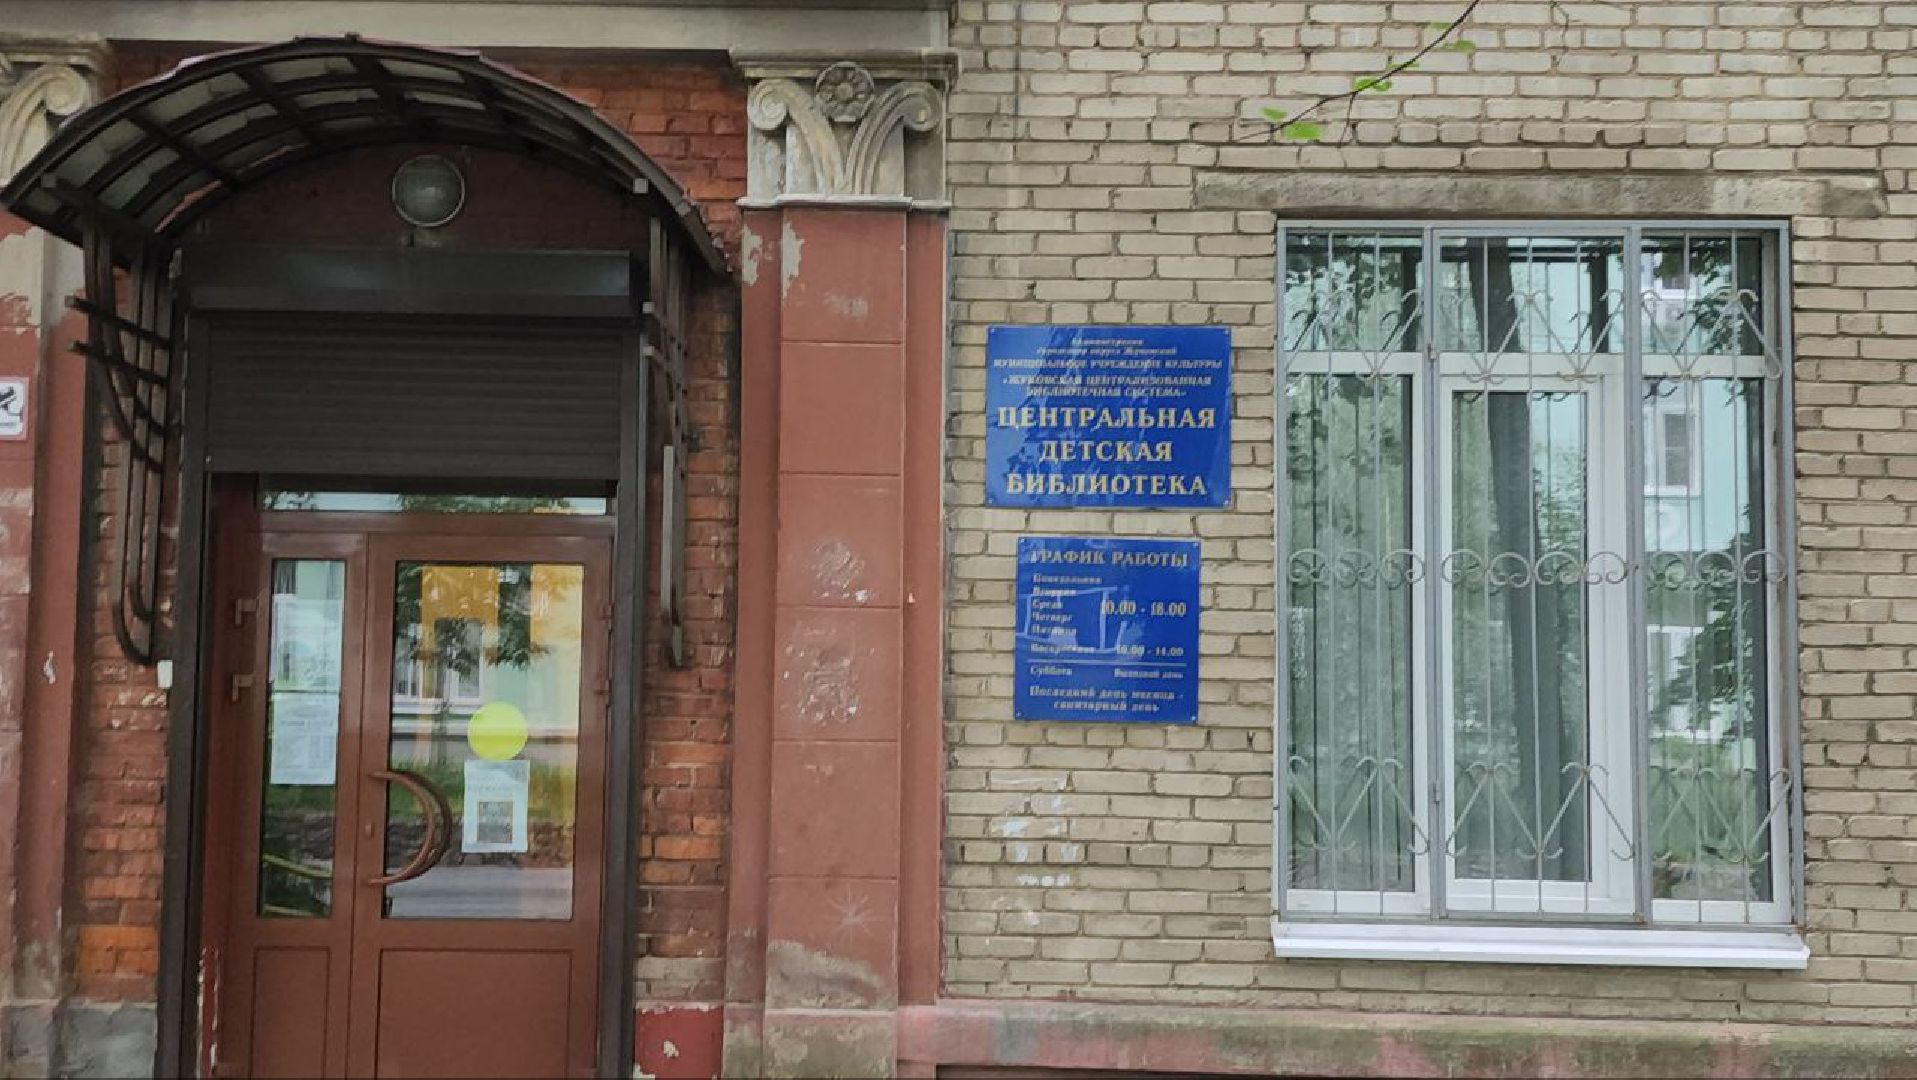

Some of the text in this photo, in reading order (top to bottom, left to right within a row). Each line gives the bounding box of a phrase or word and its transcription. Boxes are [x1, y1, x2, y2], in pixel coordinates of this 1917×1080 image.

[1091, 360, 1161, 369] УЧРЕЖДЕНИЕ
[1165, 360, 1222, 369] КУЛЬТУРЫ
[1087, 376, 1211, 386] ЦЕНТРАЛИЗОВАННАЯ
[997, 407, 1215, 430] ЦЕНТРАЛЬНАЯ
[1039, 440, 1172, 464] ДЕТСКАЯ
[1007, 473, 1207, 496] БИБЛИОТЕКА
[1030, 550, 1188, 566] ГРАФИК РАБОТЫ
[1101, 601, 1136, 616] 10.00
[1151, 602, 1186, 617] 18.00
[1030, 686, 1095, 698] Последний
[1098, 689, 1127, 699] день
[1054, 699, 1127, 711] санитарный
